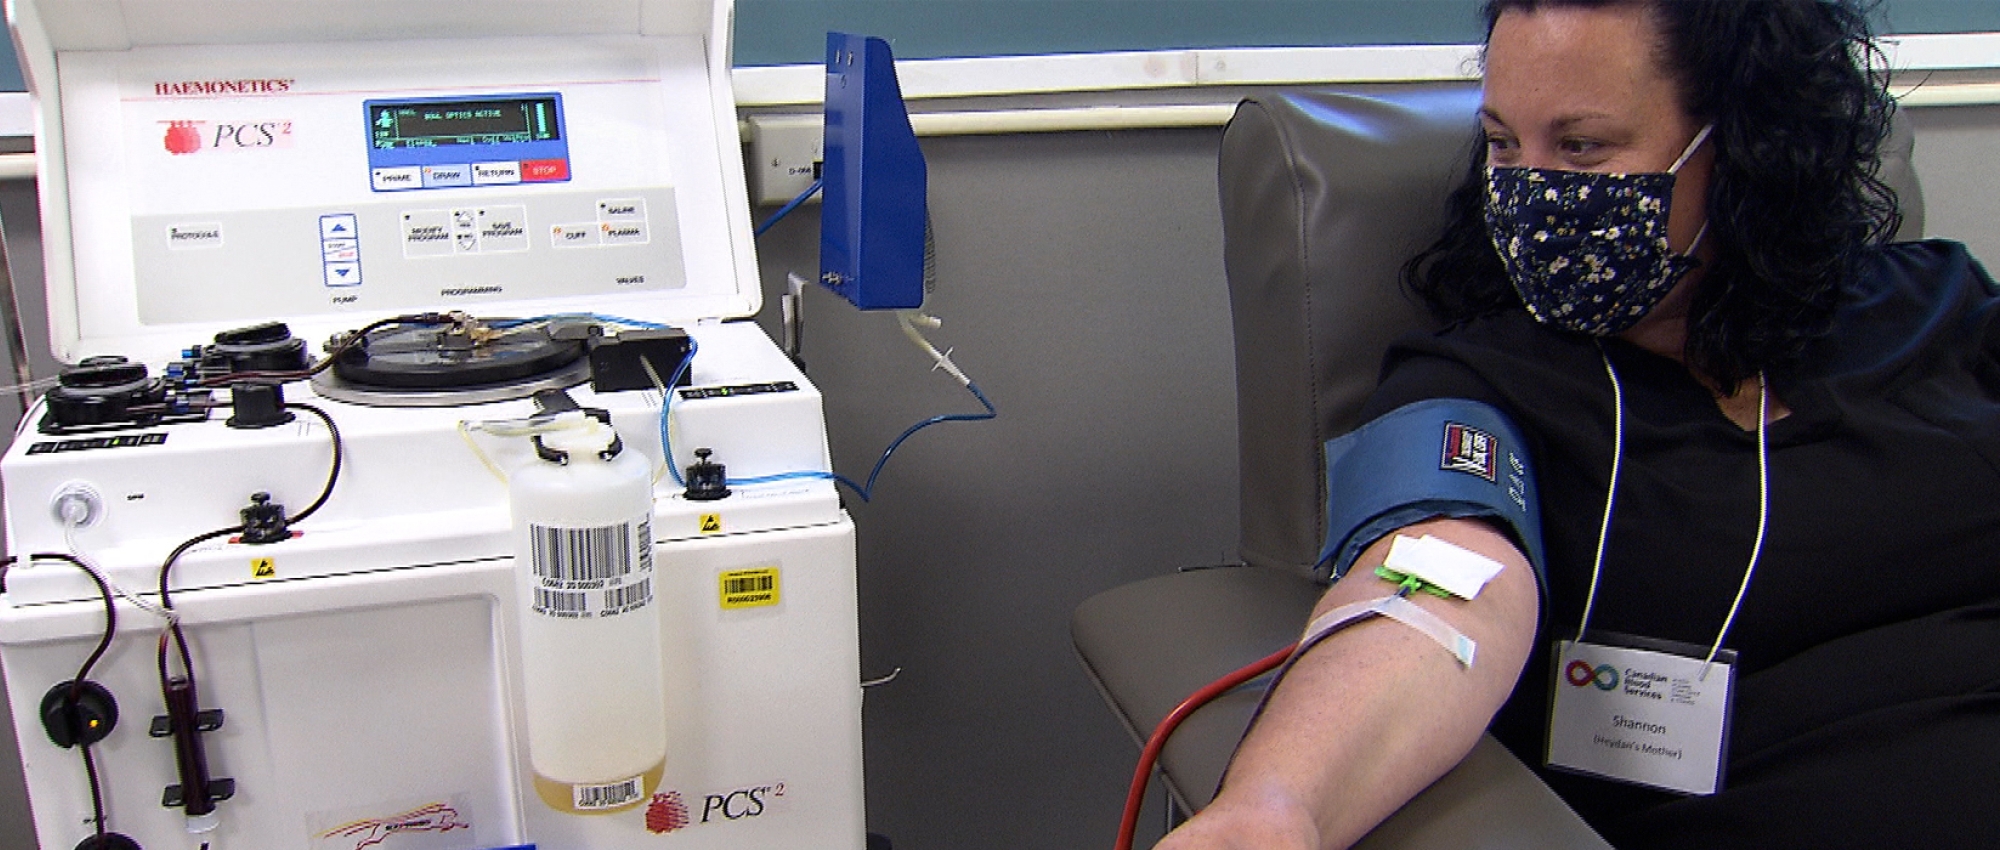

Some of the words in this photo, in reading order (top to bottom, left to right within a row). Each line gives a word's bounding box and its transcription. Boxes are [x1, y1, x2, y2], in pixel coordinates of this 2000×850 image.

[212, 122, 275, 148] PCS
[432, 171, 461, 181] DRAW
[532, 165, 558, 176] STOP
[1624, 668, 1668, 682] Canadian
[1624, 685, 1662, 700] Services
[1613, 714, 1667, 734] Shannon
[700, 787, 764, 823] PCS
[774, 782, 785, 797] 2
